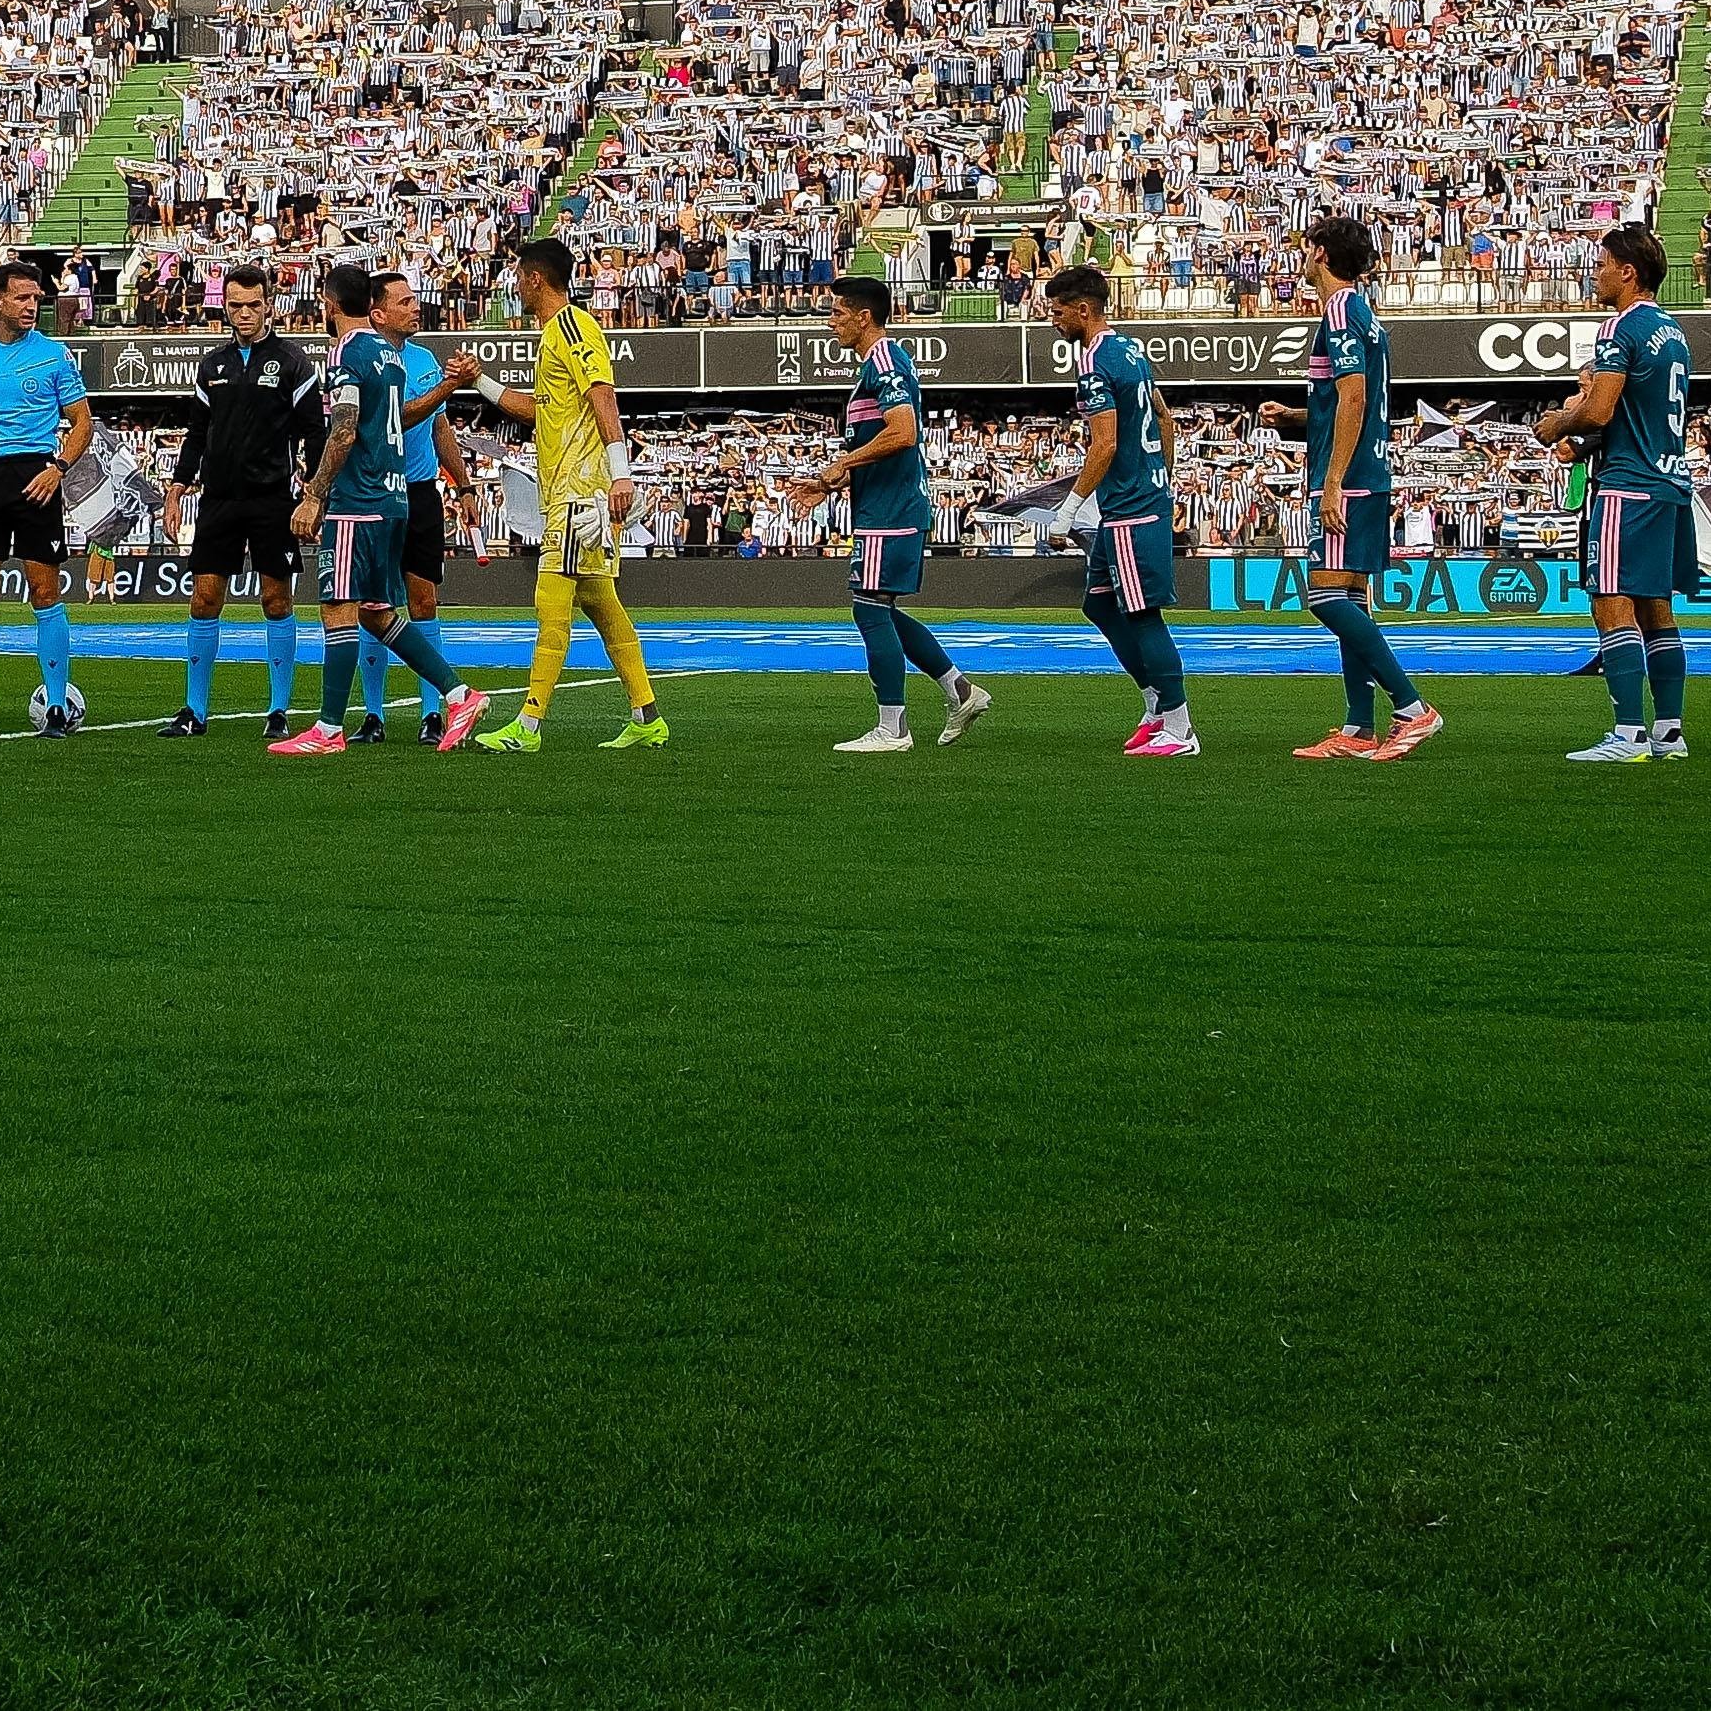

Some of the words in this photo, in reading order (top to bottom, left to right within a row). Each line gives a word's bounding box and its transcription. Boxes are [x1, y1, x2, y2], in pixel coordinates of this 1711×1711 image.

[165, 346, 200, 357] MAYOR
[461, 341, 538, 362] HOTEL
[807, 337, 948, 364] TORCID
[499, 369, 534, 383] BENI
[823, 367, 855, 378] Family
[1668, 361, 1686, 437] 5
[387, 385, 404, 456] 4
[1236, 558, 1451, 612] LAGA
[1490, 568, 1536, 591] EA
[1489, 591, 1537, 603] SPORTS
